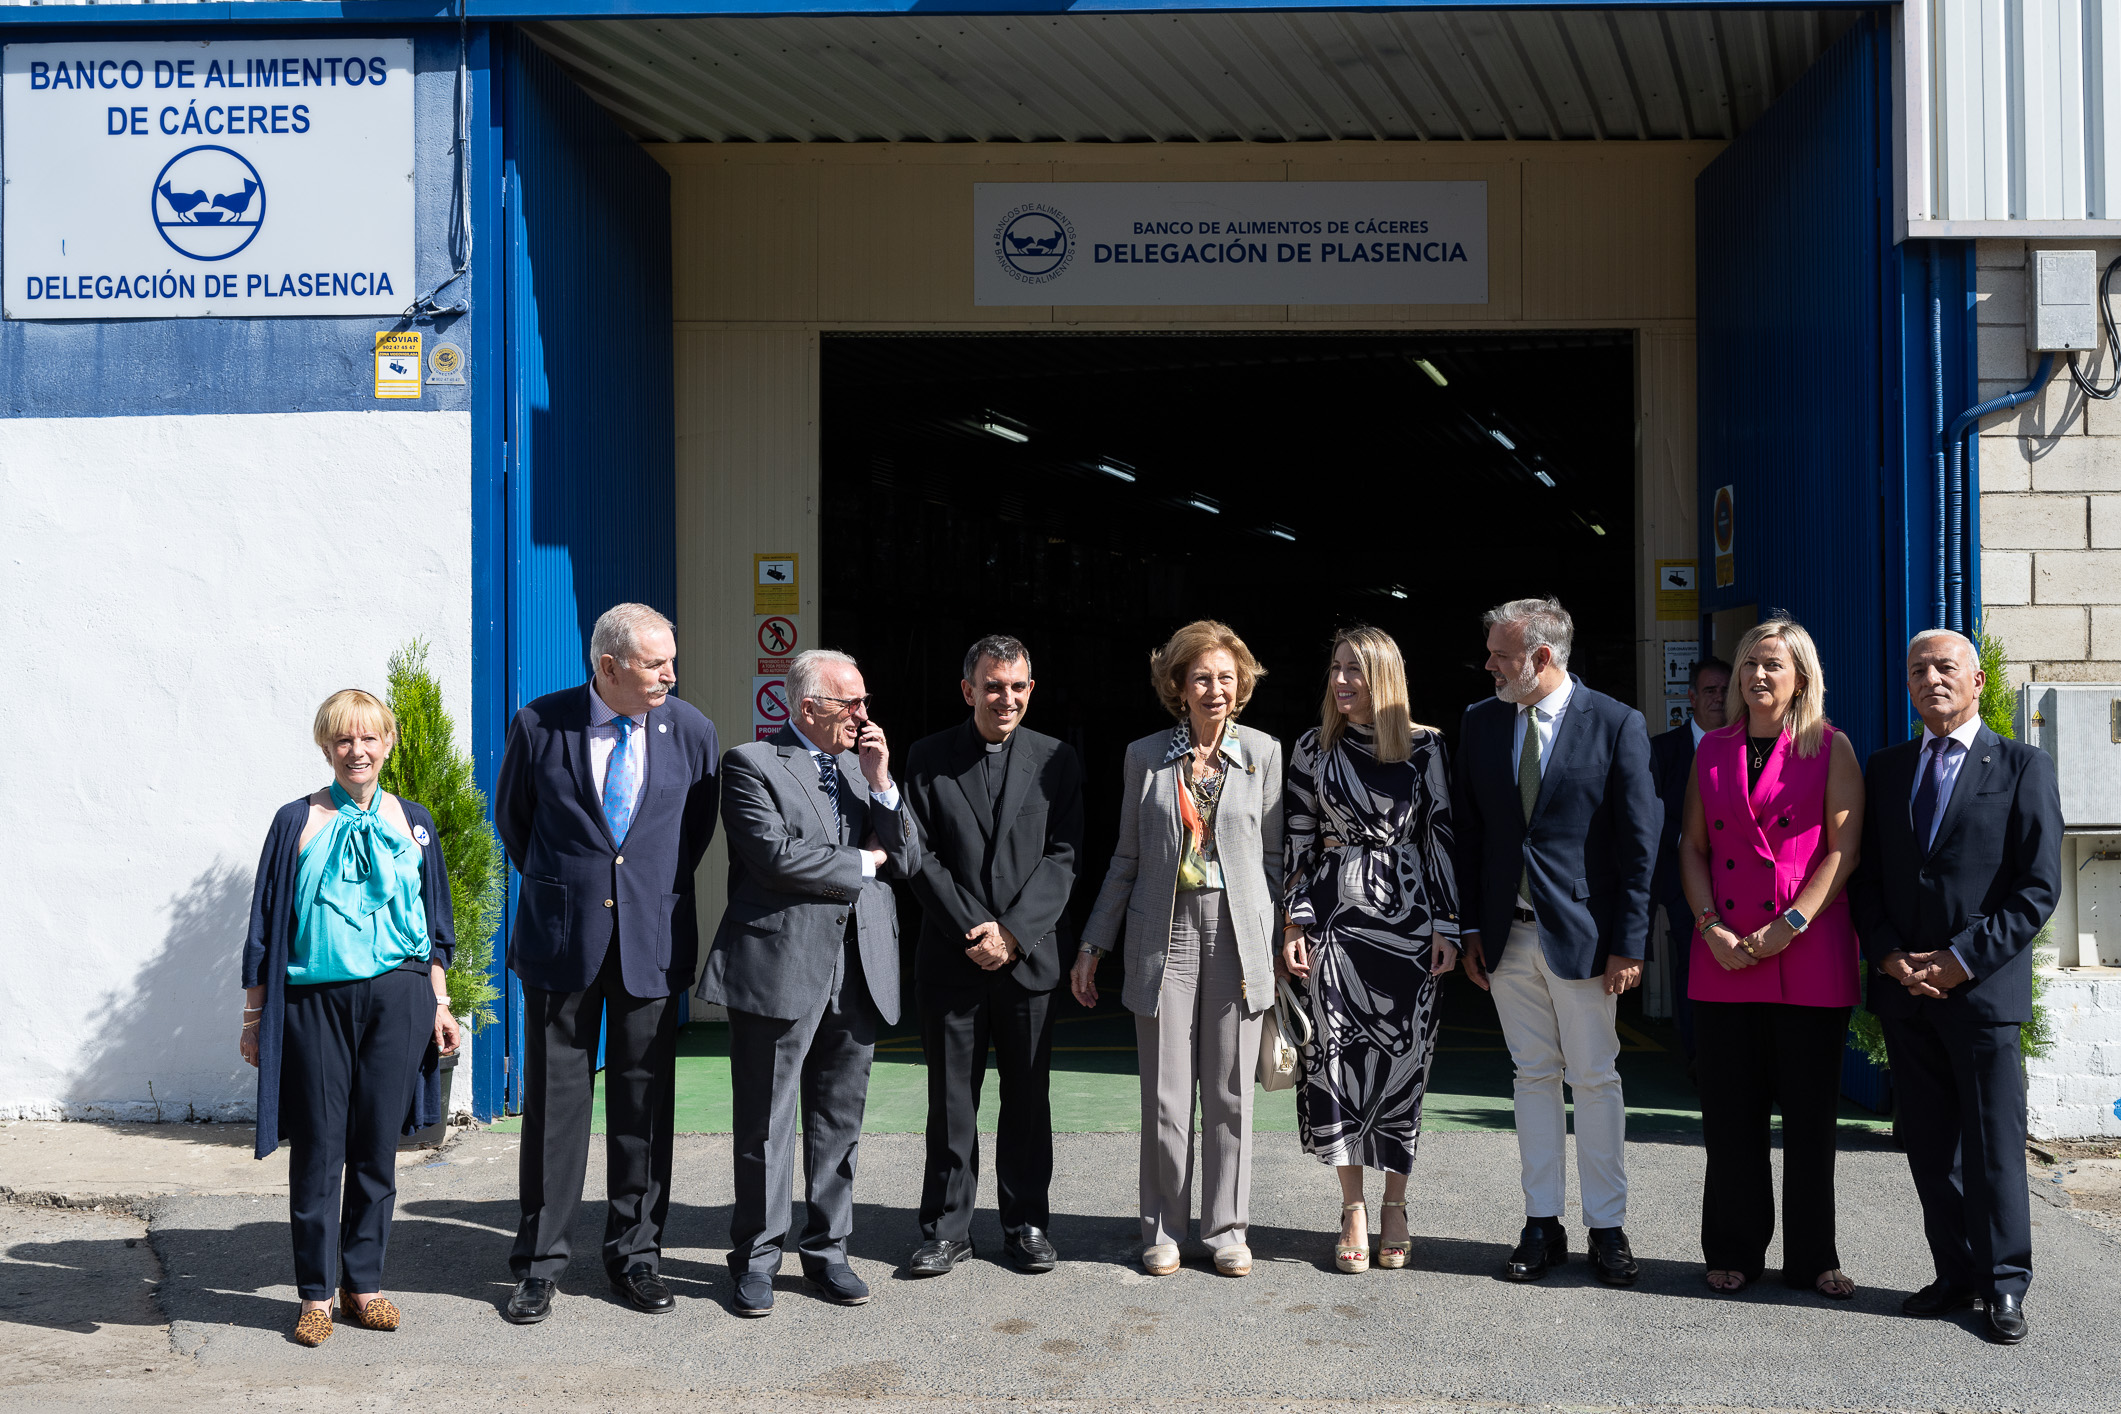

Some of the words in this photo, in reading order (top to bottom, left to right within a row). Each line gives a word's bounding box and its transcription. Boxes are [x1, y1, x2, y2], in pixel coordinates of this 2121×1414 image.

[30, 59, 144, 90] BANCO
[154, 59, 195, 89] DE
[204, 56, 387, 88] ALIMENTOS
[107, 106, 149, 136] DE
[159, 98, 310, 135] CÁCERES
[993, 207, 1020, 240] BANCOS
[1021, 203, 1034, 212] DE
[1036, 203, 1077, 240] ALIMENTOS
[1133, 221, 1194, 235] BANCO
[1199, 221, 1221, 235] DE
[1226, 221, 1322, 235] ALIMENTOS
[1327, 221, 1350, 235] DE
[1355, 217, 1429, 234] CÁCERES
[994, 249, 1021, 281] BANCOS
[1021, 276, 1034, 285] DE
[1035, 249, 1076, 285] ALIMENTOS
[1094, 238, 1267, 264] DELEGACIÓN
[1277, 242, 1312, 263] DE
[1321, 241, 1468, 263] PLASENCIA
[27, 269, 195, 300] DELEGACIÓN
[204, 274, 238, 298] DE
[246, 272, 394, 298] PLASENCIA
[1754, 757, 1763, 769] B
